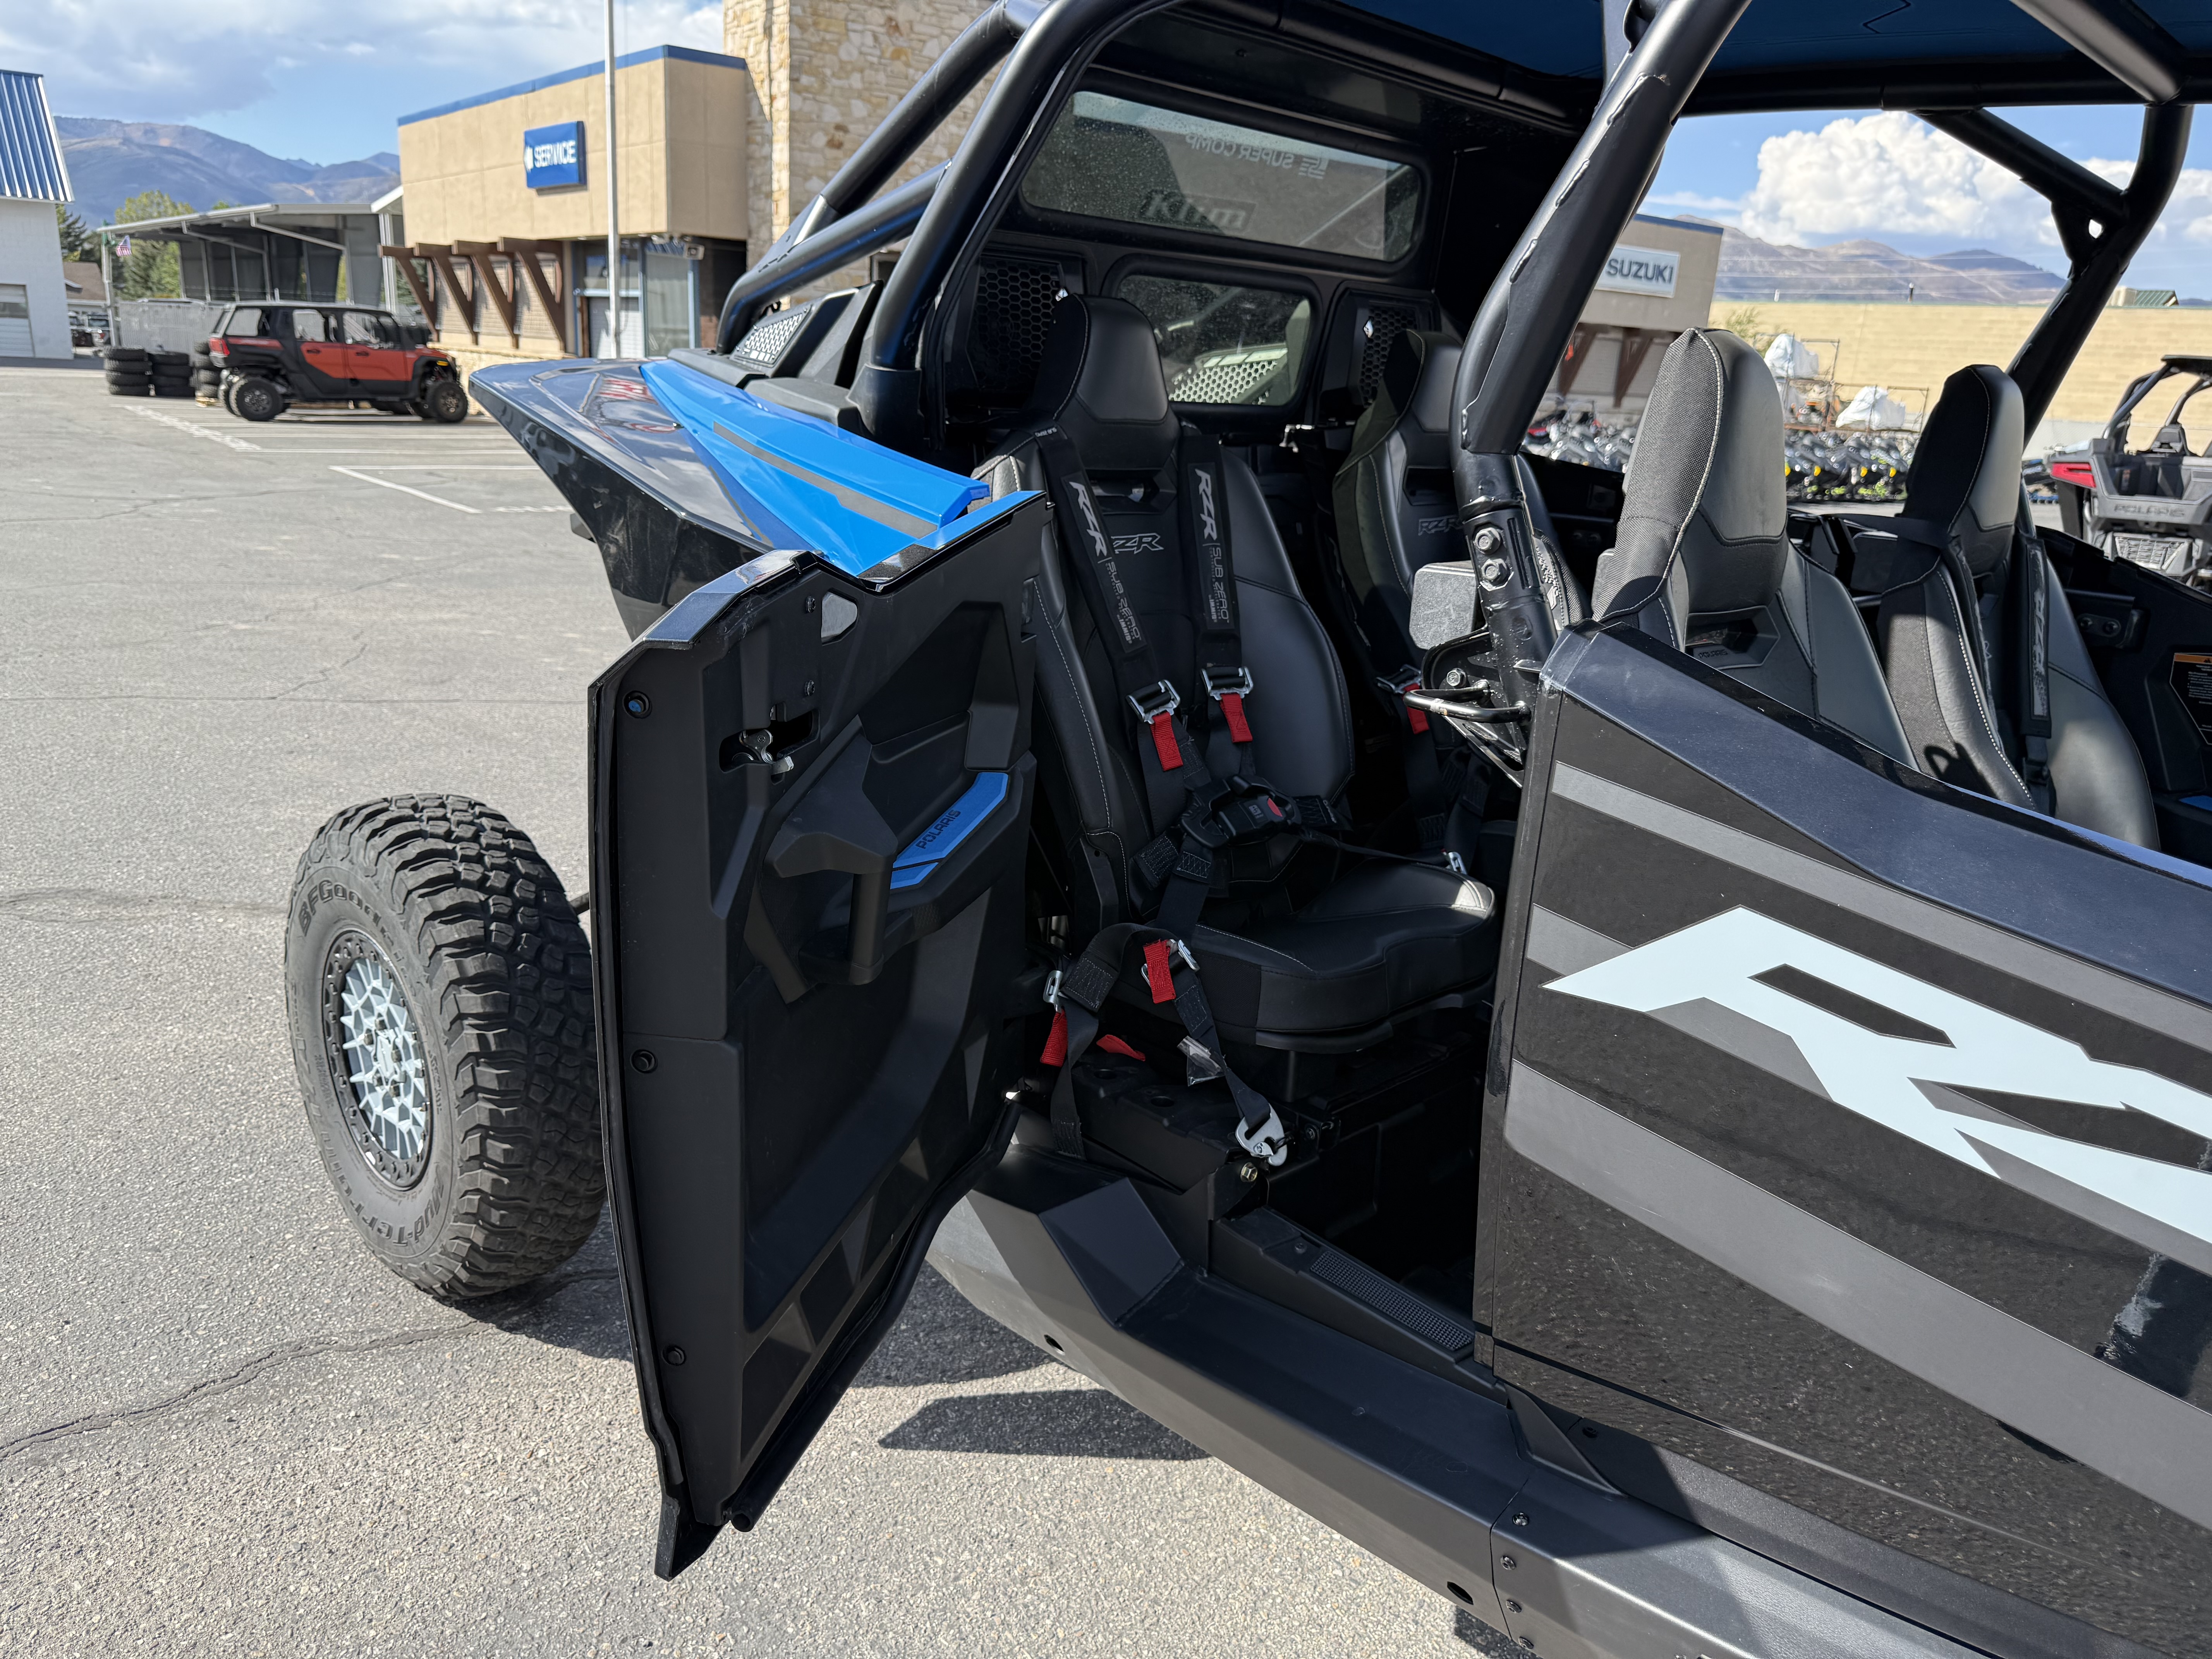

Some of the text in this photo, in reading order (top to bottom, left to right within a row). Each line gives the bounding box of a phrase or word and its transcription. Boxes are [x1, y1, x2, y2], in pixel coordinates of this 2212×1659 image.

[534, 139, 577, 168] SERVICE
[1607, 258, 1674, 284] SUZUKI
[1068, 481, 1107, 557] RZR
[1195, 469, 1217, 541] RZR
[1111, 533, 1164, 554] ZR
[1108, 562, 1140, 639] SUB ZERO
[1212, 547, 1229, 620] SUB ZERO
[915, 809, 961, 849] POLARIS
